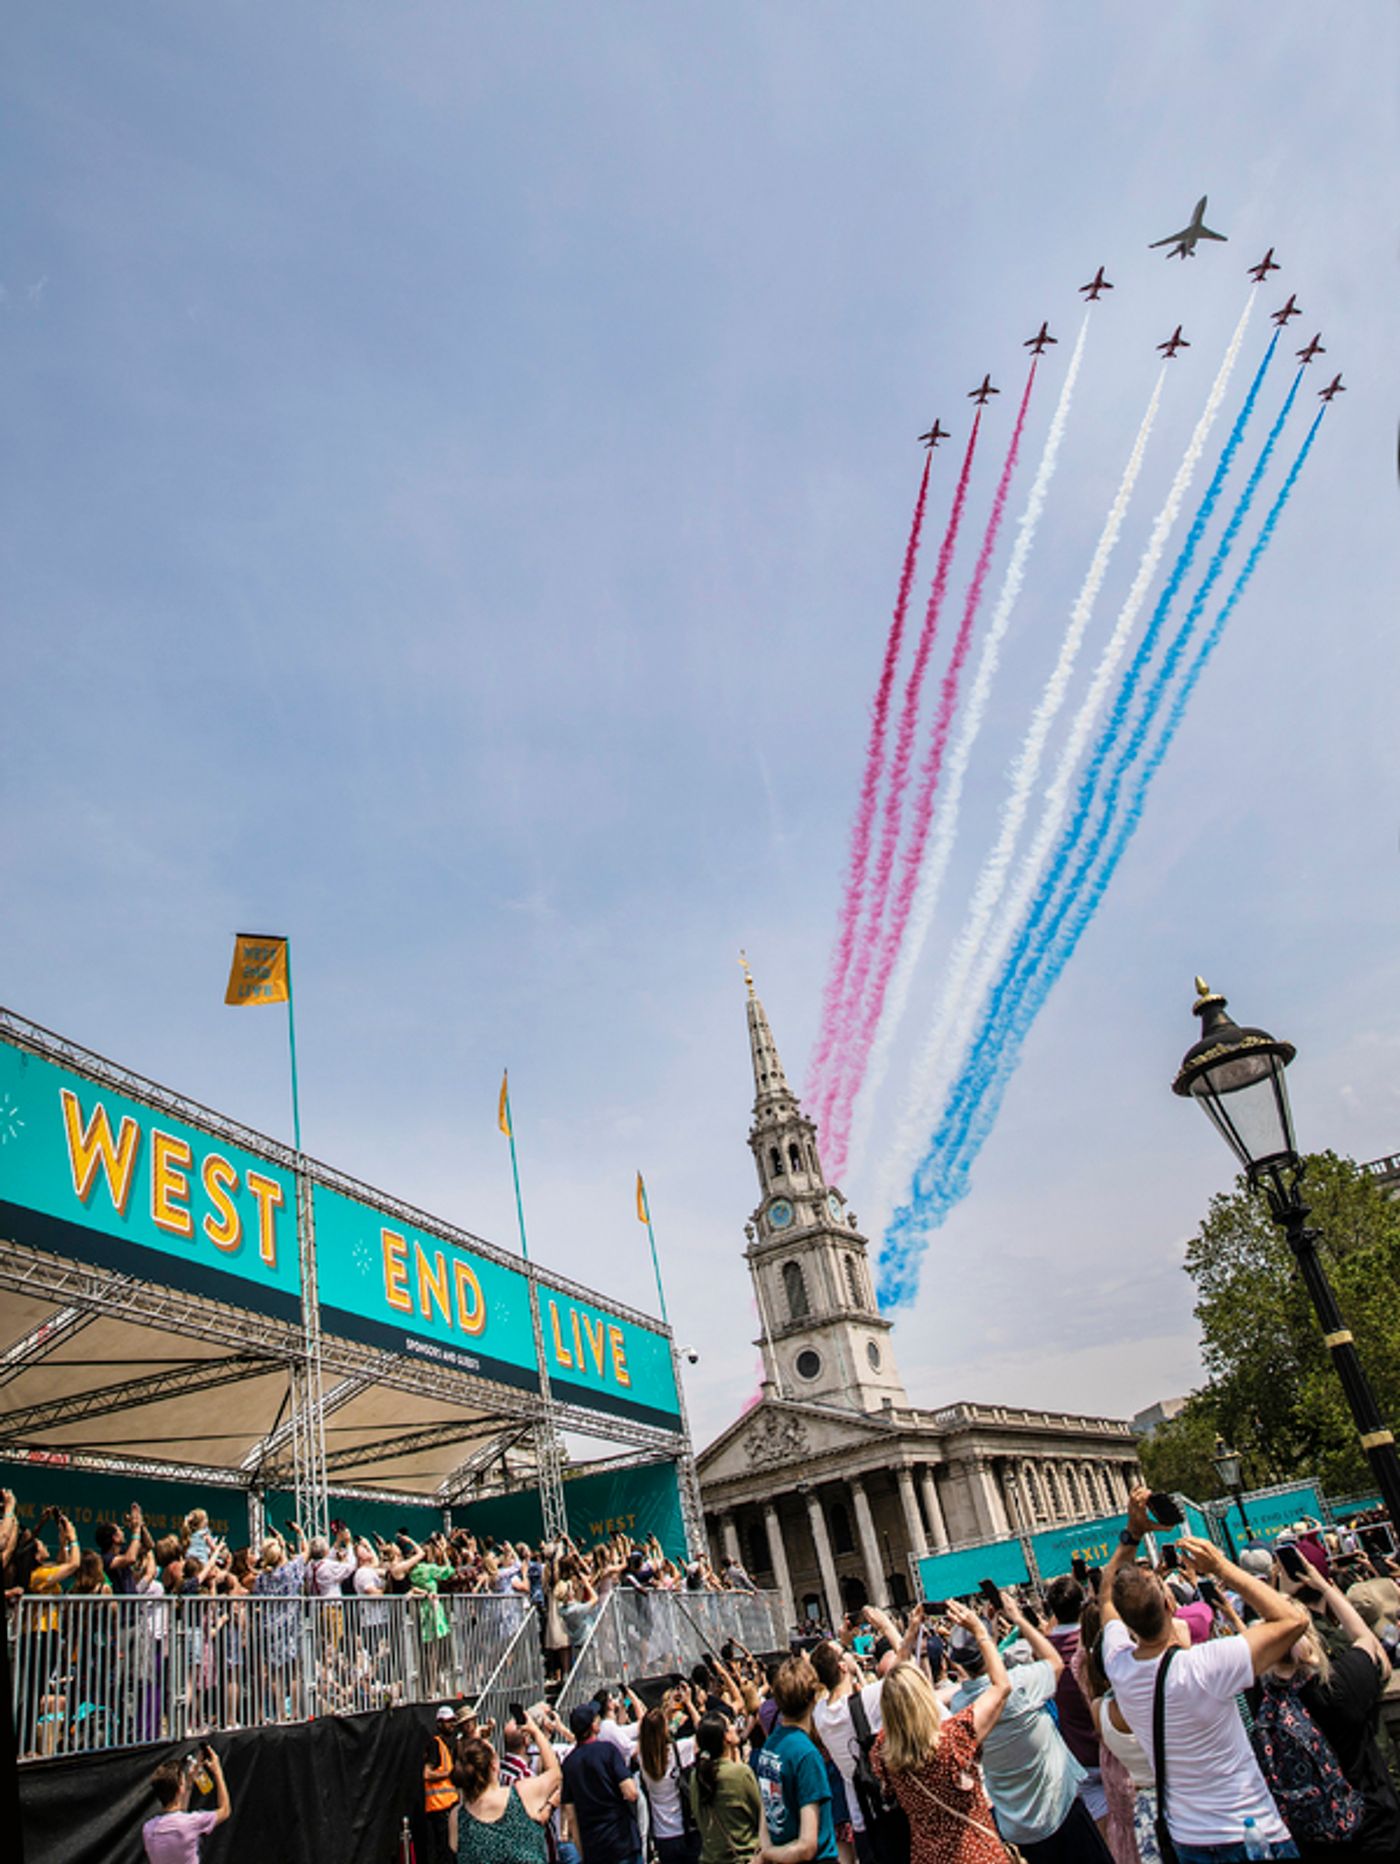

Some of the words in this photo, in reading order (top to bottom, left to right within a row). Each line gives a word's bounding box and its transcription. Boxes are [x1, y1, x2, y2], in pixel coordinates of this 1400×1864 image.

[59, 1087, 283, 1268] WEST
[381, 1227, 486, 1335] END
[549, 1300, 632, 1388] LIVE
[588, 1514, 636, 1536] WEST
[1071, 1542, 1108, 1562] EXIT
